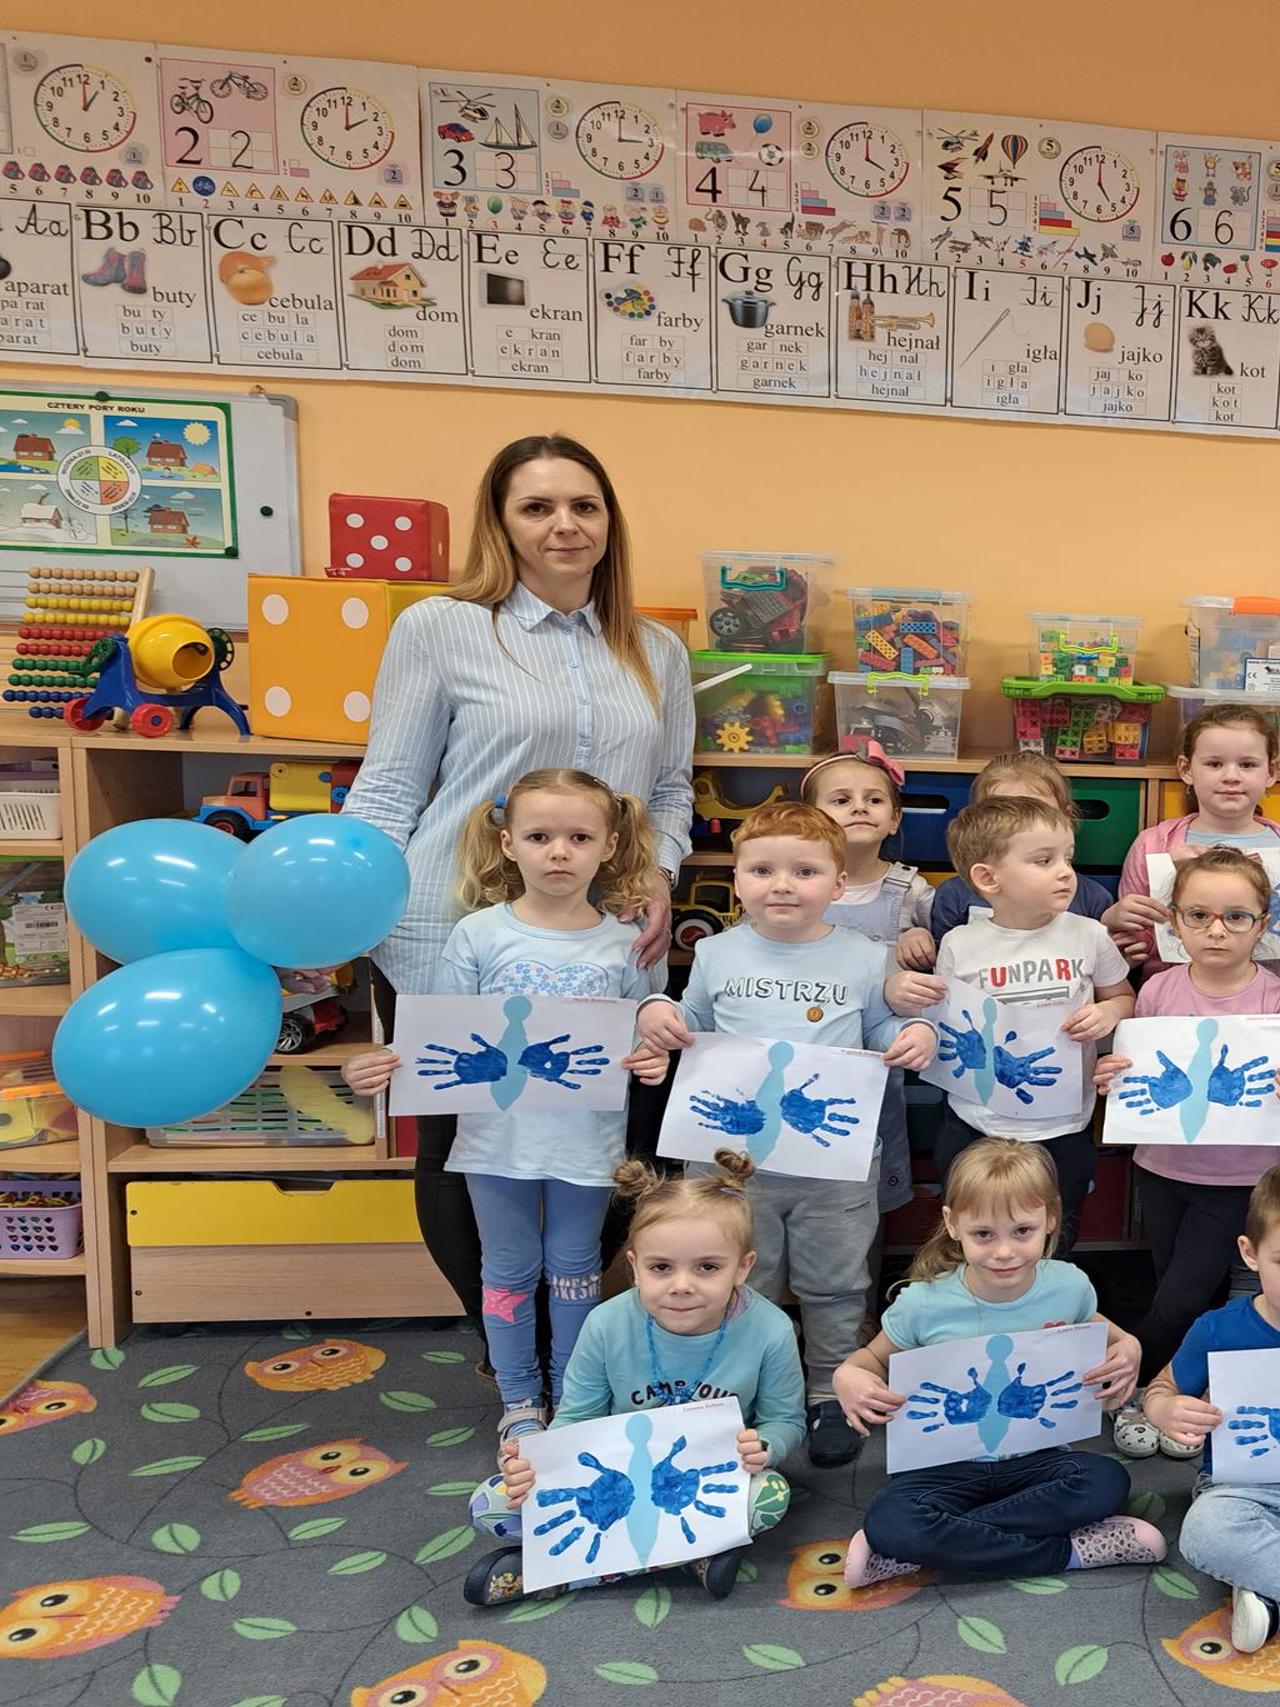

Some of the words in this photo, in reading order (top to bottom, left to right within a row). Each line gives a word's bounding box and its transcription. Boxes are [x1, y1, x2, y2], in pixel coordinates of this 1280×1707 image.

[174, 126, 203, 166] 2
[230, 130, 255, 170] 2
[443, 149, 467, 187] 3
[495, 152, 516, 189] 3
[10, 184, 17, 194] 5
[35, 185, 43, 196] 6
[61, 187, 68, 197] 7
[85, 189, 94, 199] 8
[112, 191, 119, 200] 9
[135, 193, 151, 204] 10
[695, 167, 722, 204] 4
[748, 169, 767, 207] 4
[178, 198, 183, 207] 1
[203, 200, 210, 208] 2
[227, 201, 235, 211] 3
[252, 203, 260, 213] 4
[277, 205, 284, 214] 5
[302, 207, 309, 216] 6
[326, 208, 333, 218] 7
[350, 210, 358, 220] 8
[374, 212, 381, 221] 9
[398, 214, 412, 223] 10
[940, 187, 962, 221] 5
[988, 190, 1008, 226] 5
[15, 204, 69, 237] Aa
[82, 209, 140, 241] Bb
[152, 213, 197, 246] Bb
[1169, 208, 1192, 241] 6
[1214, 210, 1234, 244] 6
[214, 219, 267, 250] Cc
[288, 222, 324, 254] Cc
[345, 225, 399, 257] Dd
[411, 229, 460, 261] Dd
[473, 233, 519, 265] Ee
[543, 239, 580, 270] Ee
[600, 242, 646, 274] Ff
[667, 247, 702, 292] Ff
[719, 252, 773, 293] Gg
[787, 256, 824, 301] Gg
[5, 280, 69, 296] aparat
[843, 261, 899, 294] Hh
[902, 265, 946, 297] Hh
[965, 271, 990, 301] Ii
[1026, 277, 1053, 306] Ii
[152, 286, 196, 308] buty
[269, 293, 334, 311] cebula
[1077, 280, 1102, 315] Jj
[1135, 285, 1164, 328] Jj
[1185, 289, 1233, 320] Kk
[1241, 294, 1280, 324] Kk
[416, 306, 459, 323] dom
[530, 304, 584, 322] ekran
[657, 311, 704, 333] farby
[764, 322, 825, 338] garnek
[130, 341, 161, 356] buty
[886, 331, 940, 351] hejnał
[256, 348, 303, 361] cebula
[391, 356, 422, 368] dom
[1026, 343, 1058, 363] igła
[1118, 346, 1163, 365] jajko
[511, 360, 549, 374] ekran
[637, 367, 671, 383] farby
[1240, 362, 1265, 379] kot
[752, 377, 796, 389] garnek
[871, 384, 909, 397] hejnał
[47, 402, 85, 410] CZTERY
[996, 394, 1019, 408] igła
[1102, 400, 1133, 414] jajko
[1215, 411, 1234, 422] kot
[979, 959, 1084, 988] FUNPARK
[724, 978, 850, 1005] MISTRZU
